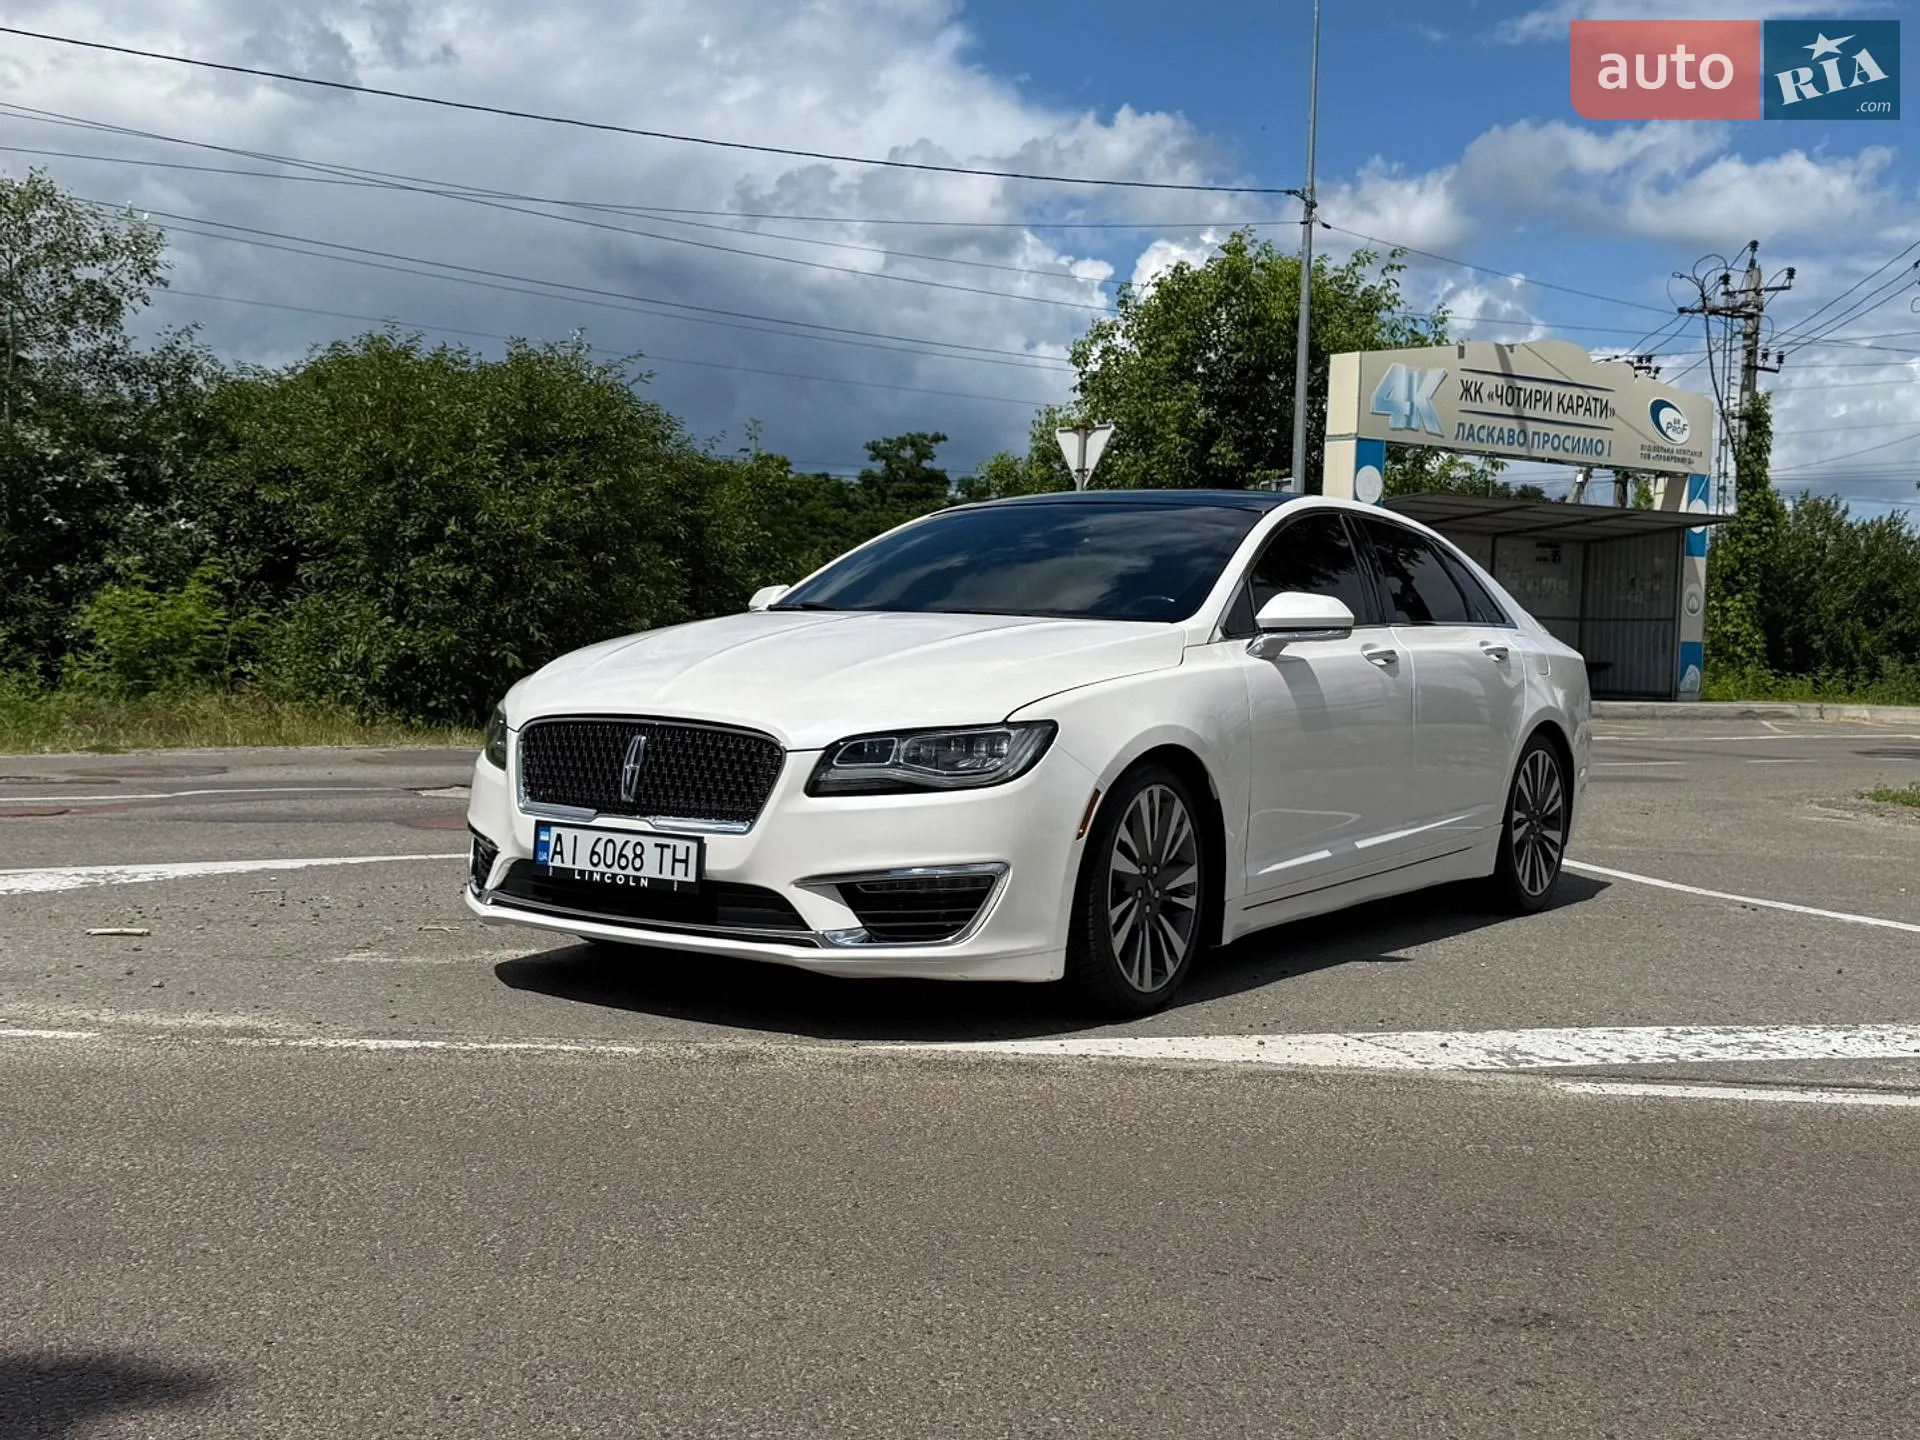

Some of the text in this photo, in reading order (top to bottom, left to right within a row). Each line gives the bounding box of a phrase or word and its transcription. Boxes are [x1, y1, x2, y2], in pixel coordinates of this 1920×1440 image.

[1459, 379, 1616, 419] ЖК «ЧОТИРИ КАРАТИ»
[1455, 422, 1528, 447] ЛАСКАВО
[589, 838, 645, 871] 6068
[654, 842, 690, 877] TH
[574, 870, 648, 887] LINCOLN
